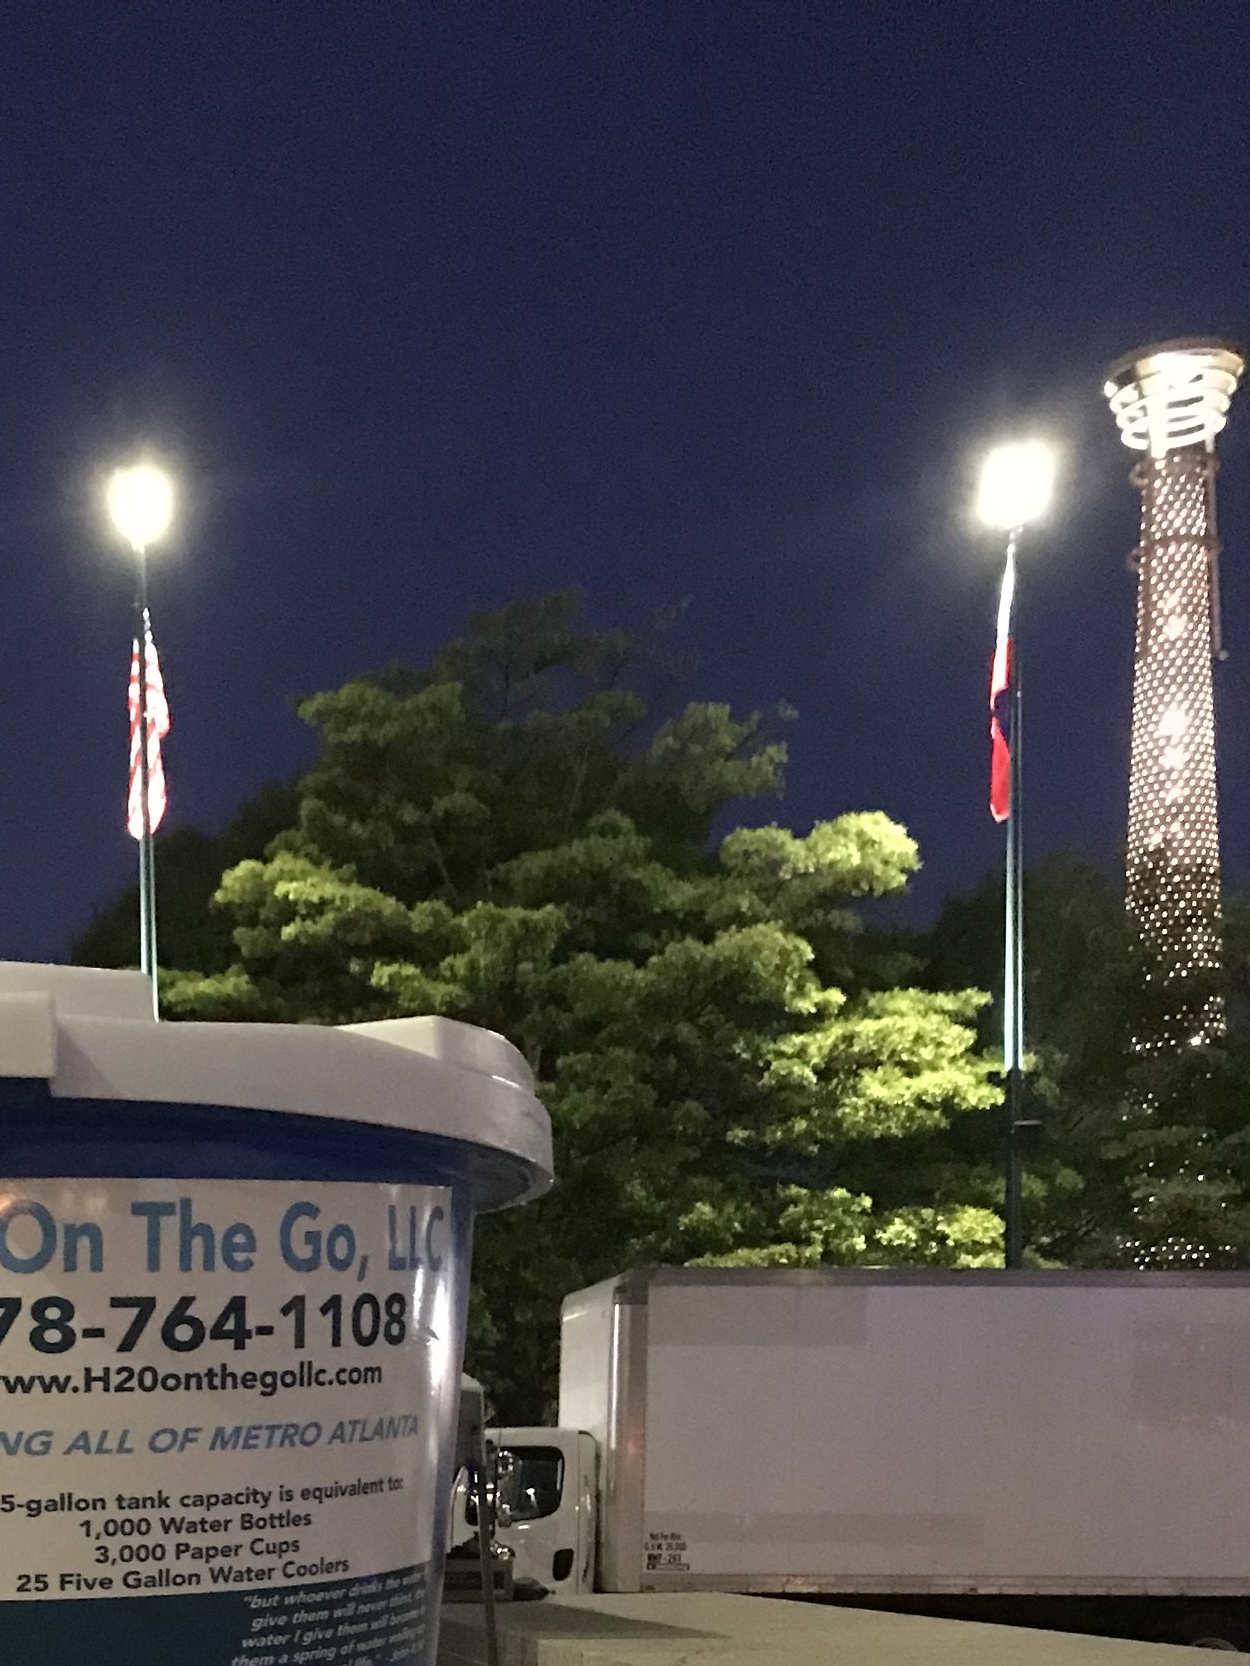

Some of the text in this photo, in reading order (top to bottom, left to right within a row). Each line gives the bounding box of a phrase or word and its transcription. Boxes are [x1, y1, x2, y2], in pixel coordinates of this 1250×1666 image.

[131, 1198, 257, 1273] The
[279, 1201, 370, 1282] Go,
[388, 1205, 444, 1273] LLC
[62, 1429, 135, 1455] ALL
[148, 1427, 203, 1453] OF
[208, 1421, 322, 1451] METRO
[328, 1413, 419, 1446] ATLANTA
[116, 1489, 171, 1511] tank
[179, 1486, 273, 1511] capacity
[278, 1484, 294, 1503] is
[300, 1477, 385, 1504] equivalent
[79, 1509, 312, 1541] 1,000 Water Bottles
[94, 1538, 301, 1566] 3,000 Paper Cups
[16, 1557, 350, 1593] 25 Five Gallon Water Coolers
[284, 1588, 348, 1605] whoever
[250, 1613, 288, 1632] give
[292, 1608, 330, 1624] them
[241, 1633, 291, 1649] water
[294, 1630, 301, 1644] I
[302, 1627, 334, 1646] give
[336, 1622, 369, 1637] them
[278, 1651, 289, 1665] a
[292, 1645, 337, 1665] spring
[339, 1639, 357, 1656] of
